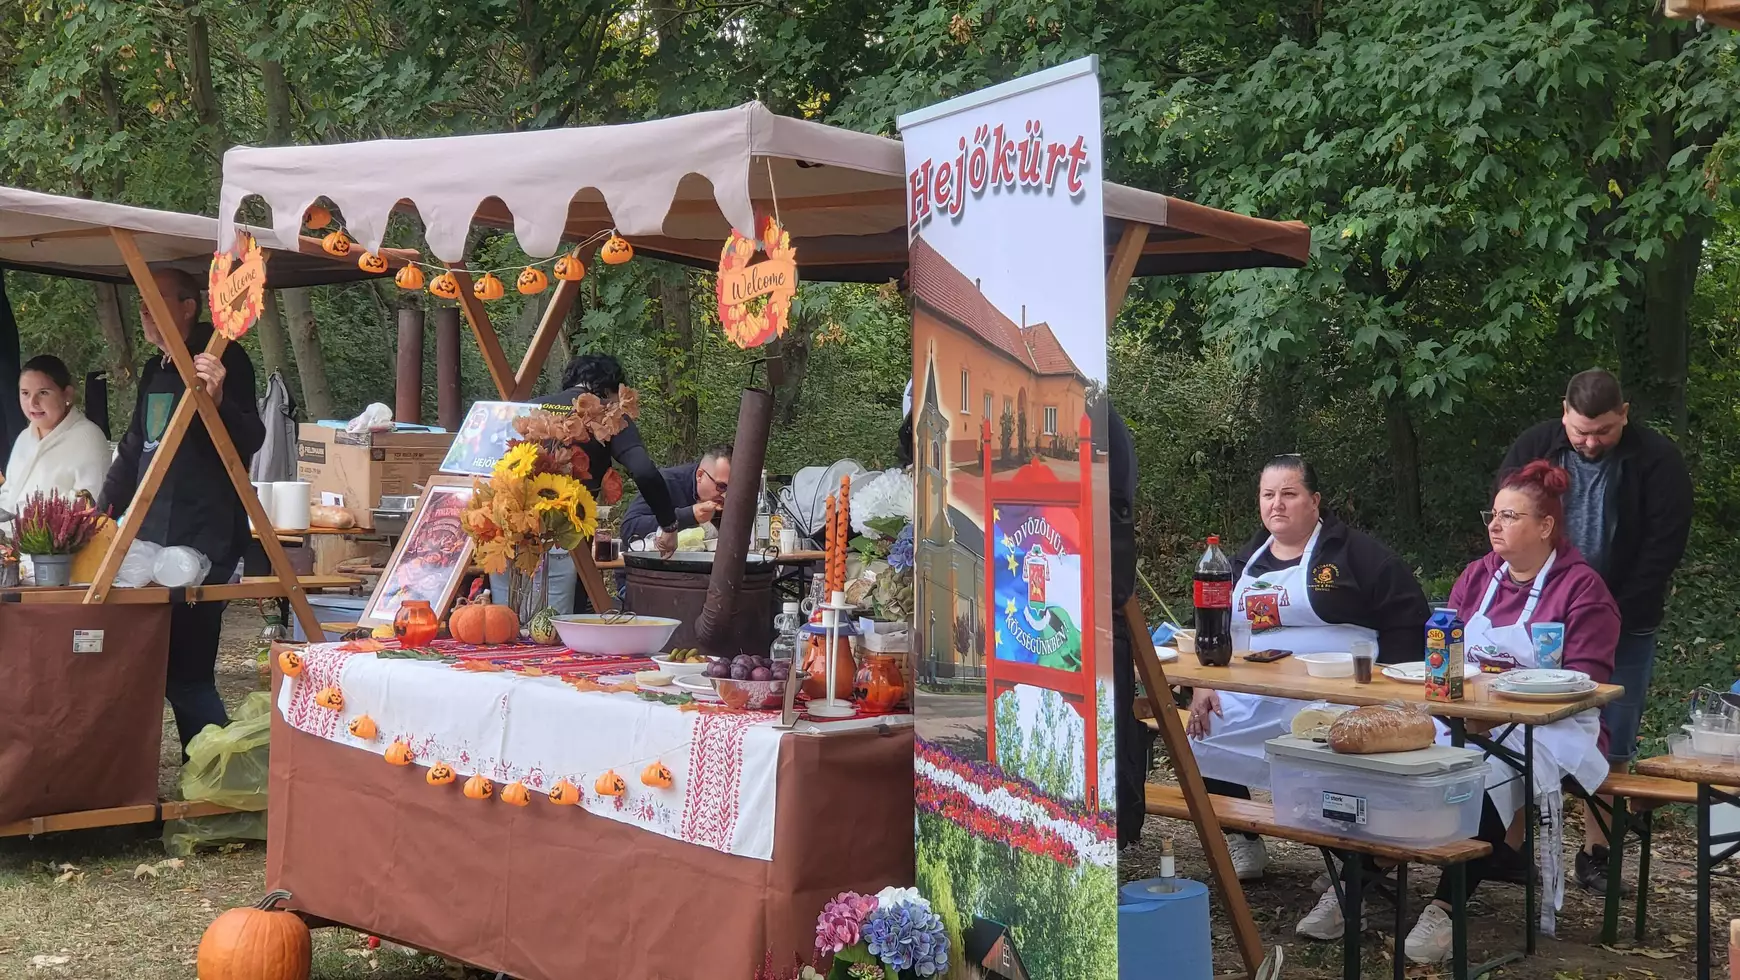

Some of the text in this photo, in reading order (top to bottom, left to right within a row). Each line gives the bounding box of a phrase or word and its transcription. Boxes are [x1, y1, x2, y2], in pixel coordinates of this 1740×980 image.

[909, 119, 1088, 229] Hejőkürt
[220, 268, 257, 306] Welcome
[732, 267, 787, 300] Welcome
